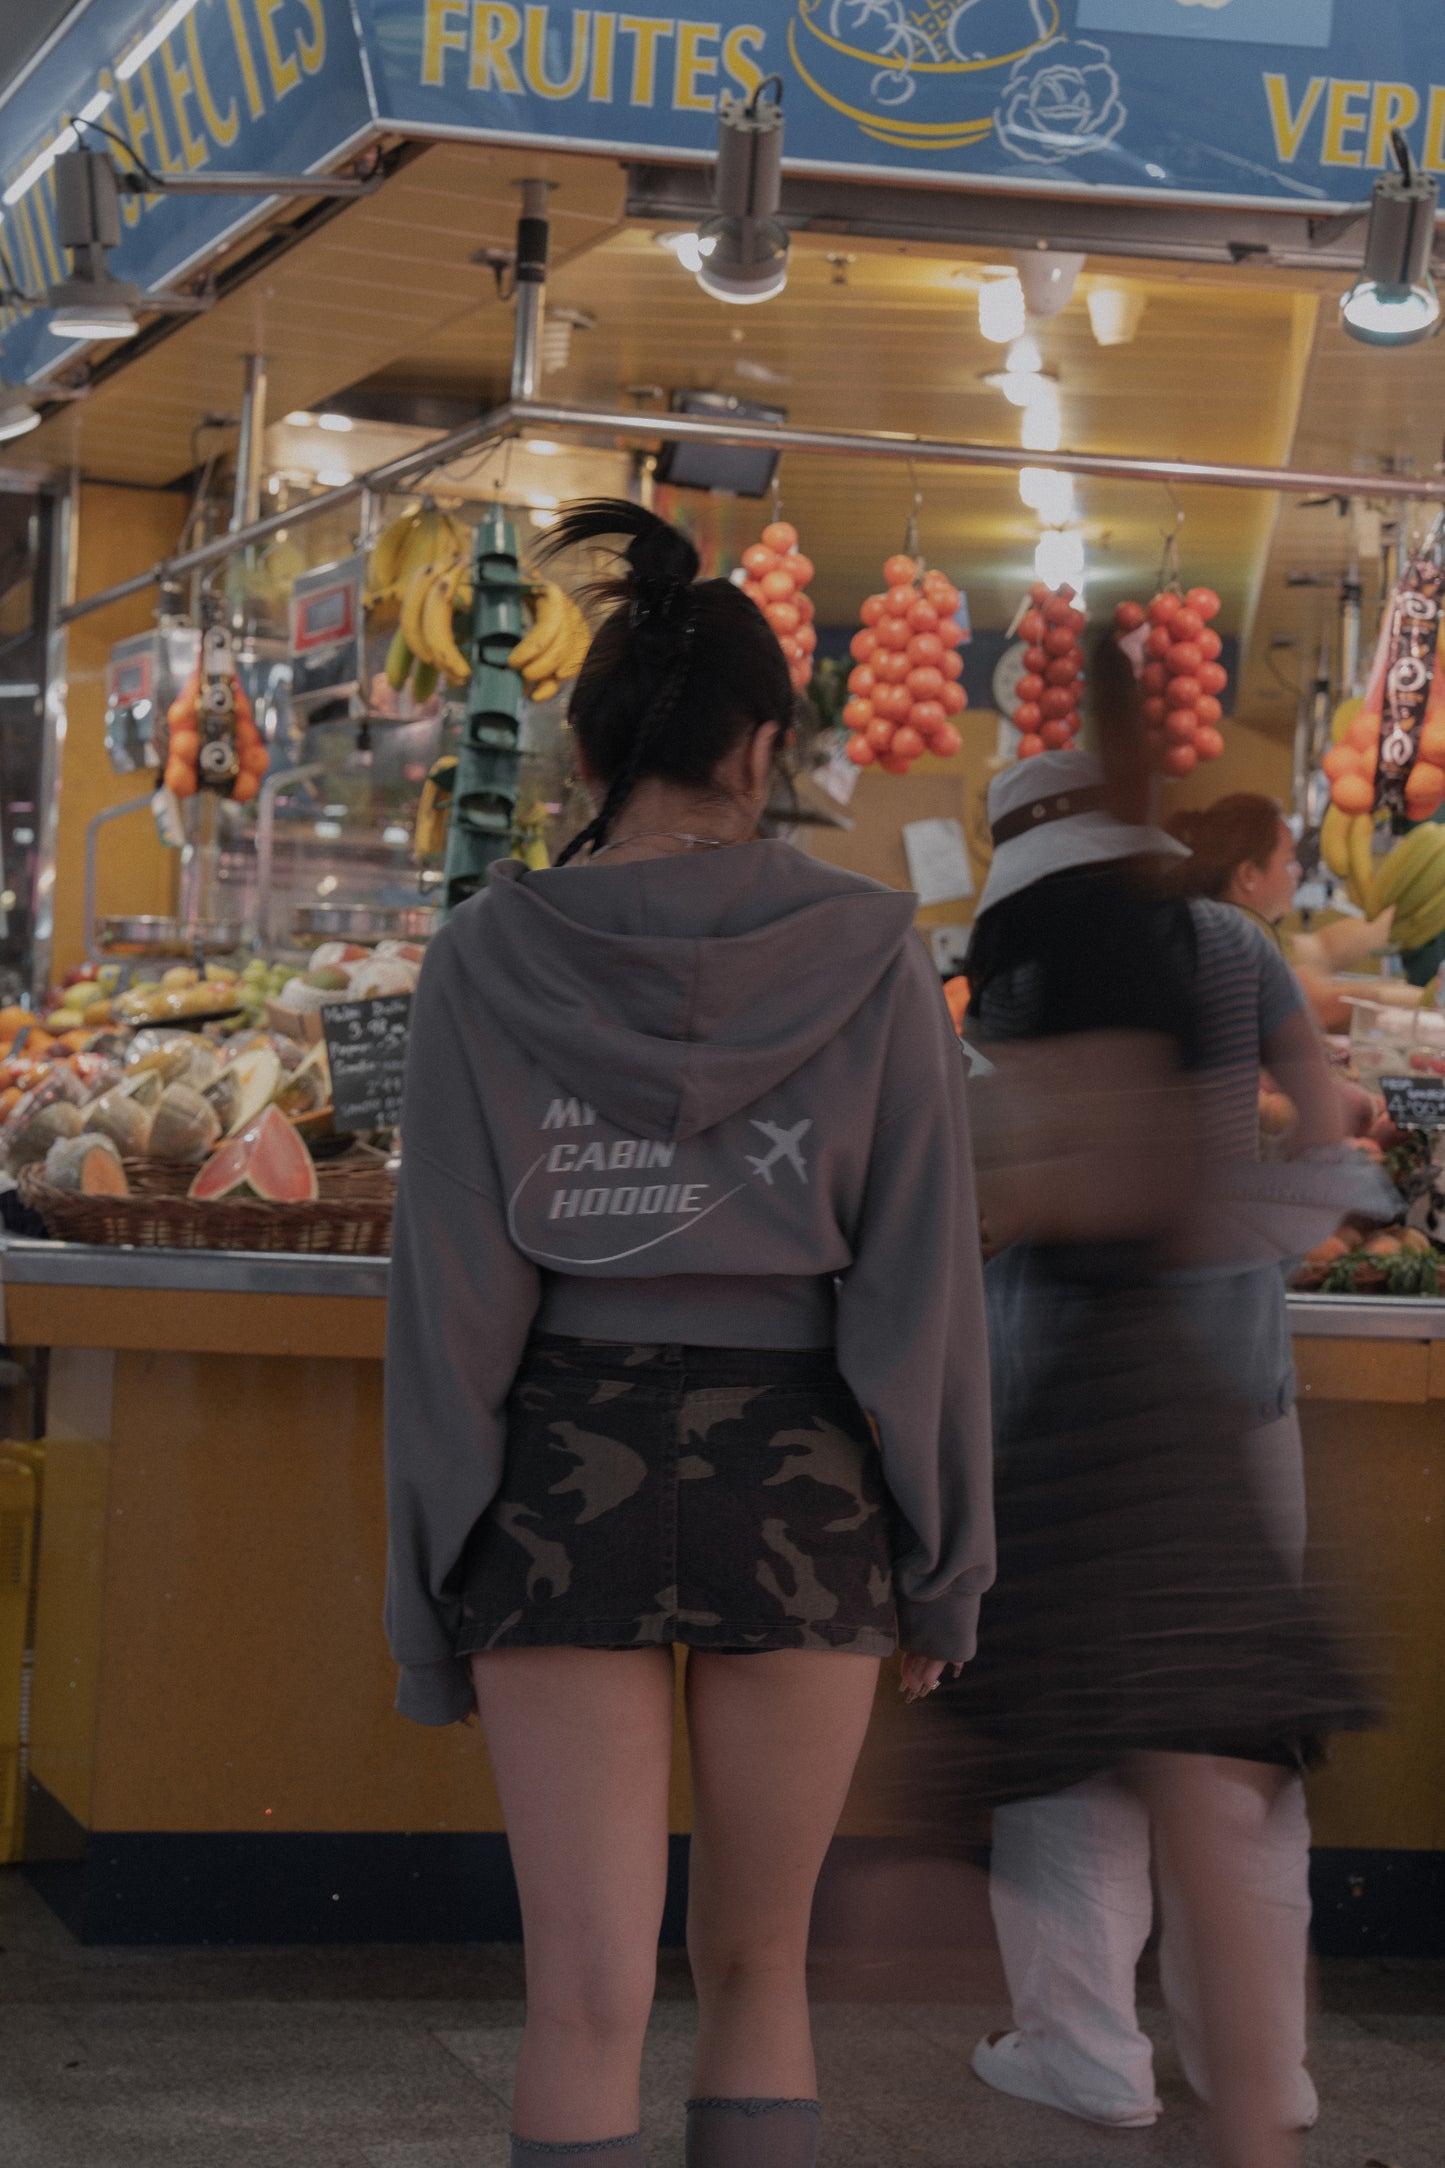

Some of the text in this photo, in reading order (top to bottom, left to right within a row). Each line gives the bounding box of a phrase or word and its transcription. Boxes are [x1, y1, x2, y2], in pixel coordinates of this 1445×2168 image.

[420, 0, 766, 114] FRUITES
[546, 1139, 678, 1173] CABIN
[548, 1183, 711, 1220] HOODIE
